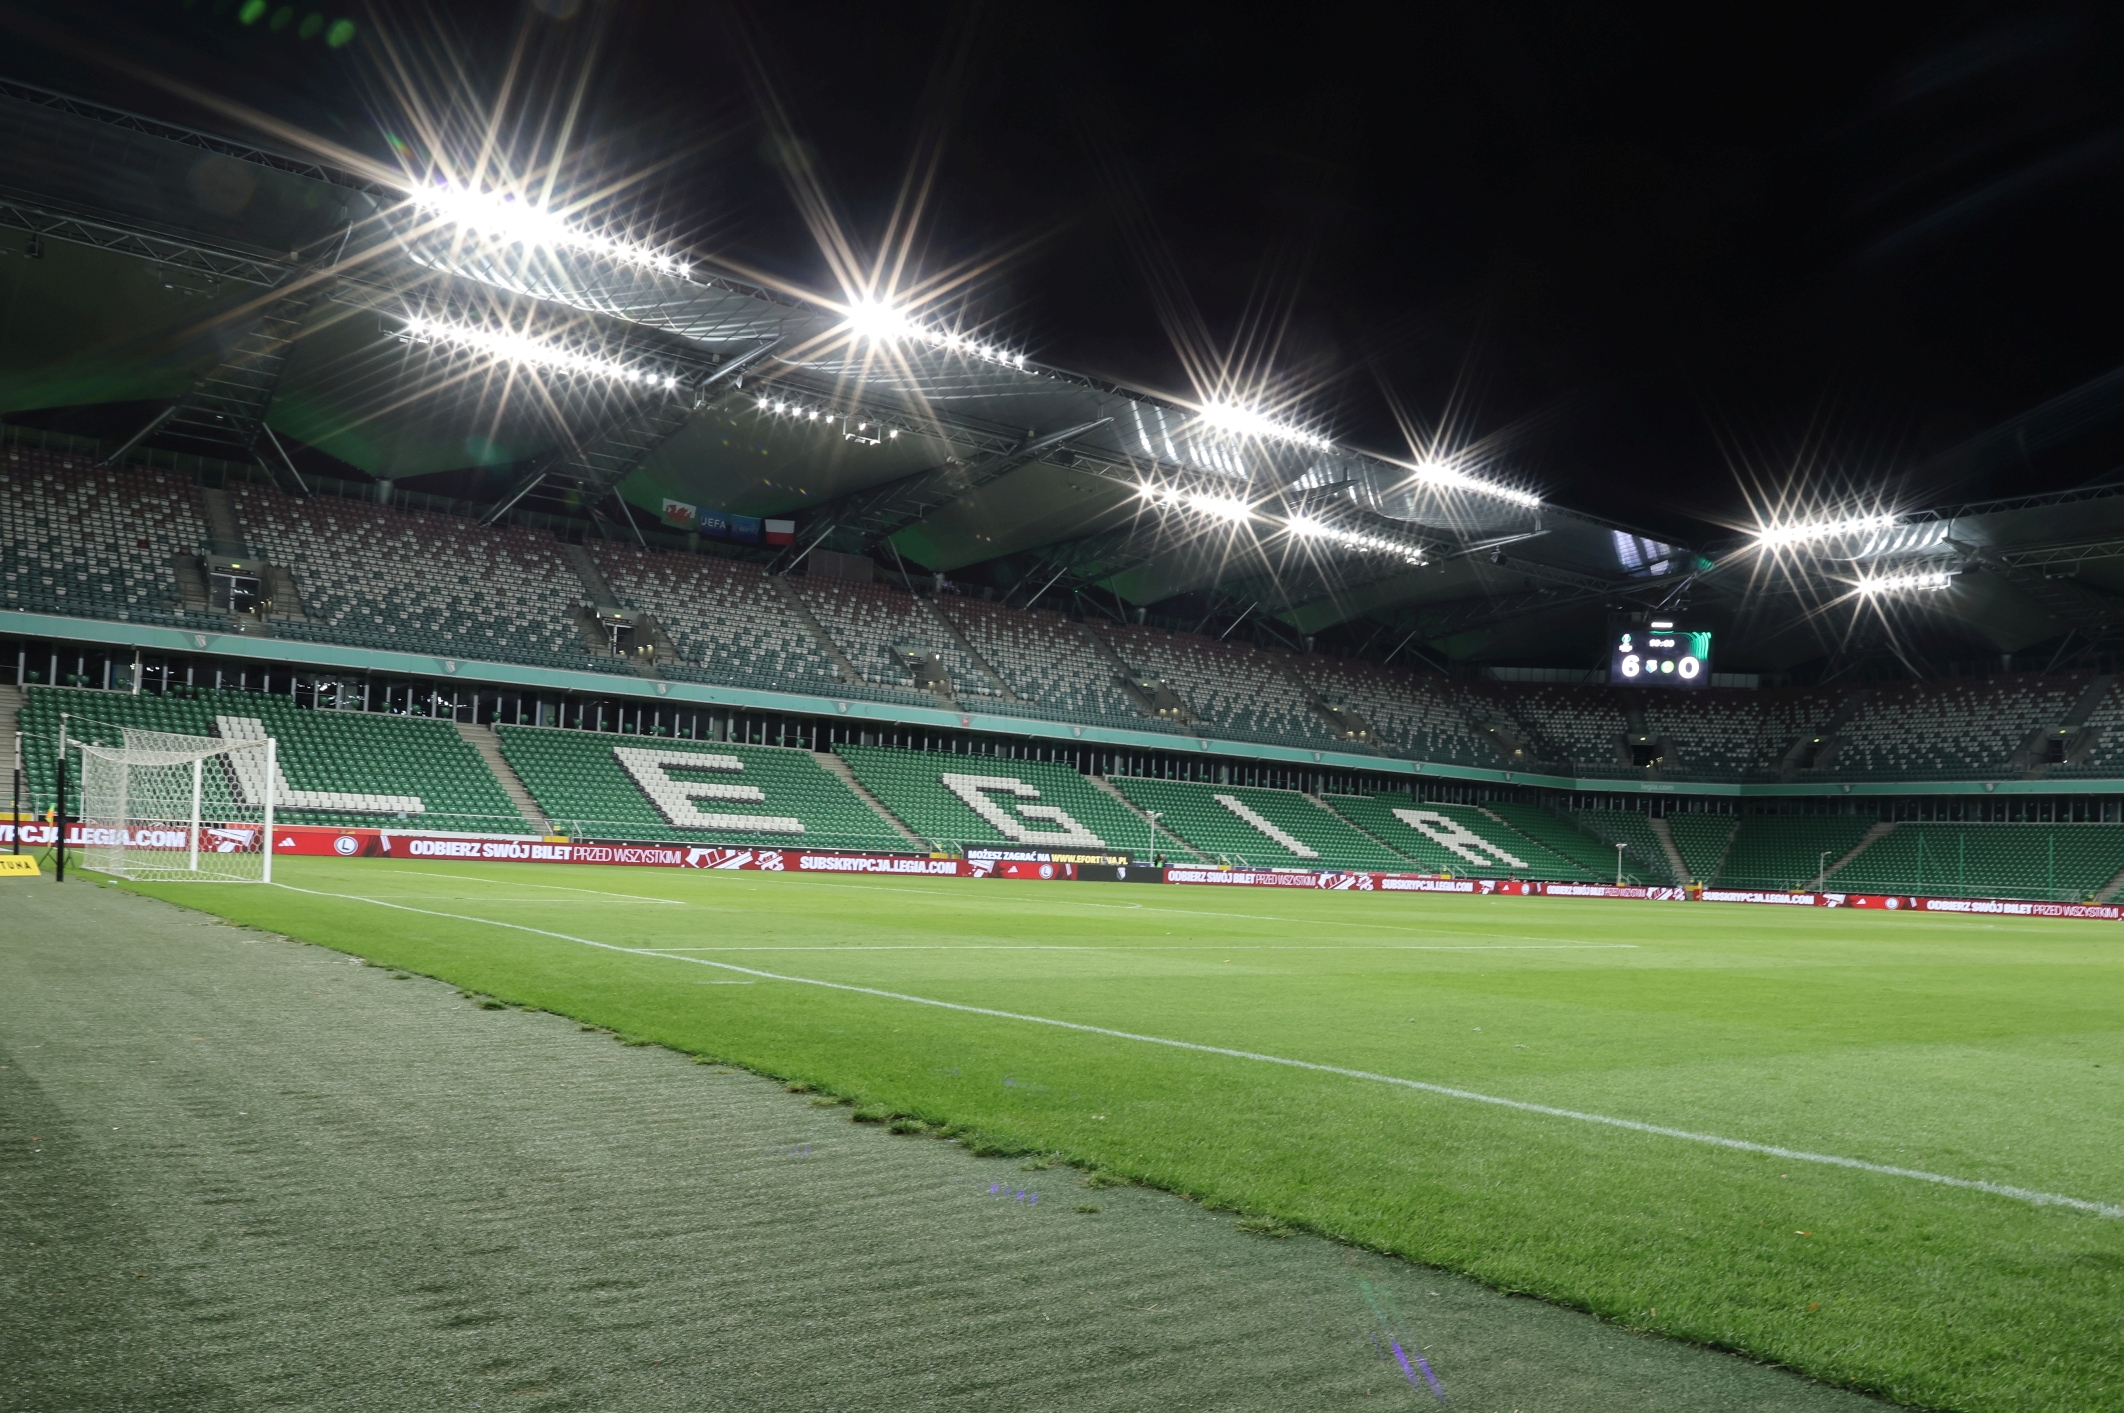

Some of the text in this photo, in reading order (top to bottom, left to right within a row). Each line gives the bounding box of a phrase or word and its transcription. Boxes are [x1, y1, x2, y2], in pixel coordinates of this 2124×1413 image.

[700, 516, 726, 529] UEFA
[1621, 654, 1699, 679] 6 0
[1640, 783, 1675, 792] legia.com
[409, 840, 681, 864] ODBIERZ SWÓJ BILET PRZED WSZYSTKIMI
[968, 849, 1128, 865] MOŻESZ ZAGRAĆ NA WWW.EFORTNA.PL
[800, 856, 957, 874] SUBSKRYPCJA.LEGIA.COM
[1168, 871, 1207, 882] ODBIERZ
[1207, 869, 1232, 884] SWÓJ
[1232, 873, 1256, 885] BILET
[1256, 874, 1277, 885] PRZED
[1381, 878, 1474, 893] SUBSKRYPCJA.LEGIA.COM
[1702, 891, 1815, 905] SUBSKRYPCJA.LEGIA.COM
[1927, 900, 1971, 911] ODBIERZ
[1972, 900, 2004, 914] SWÓJ
[2004, 904, 2032, 914] BILET
[2033, 905, 2062, 916] PRZED
